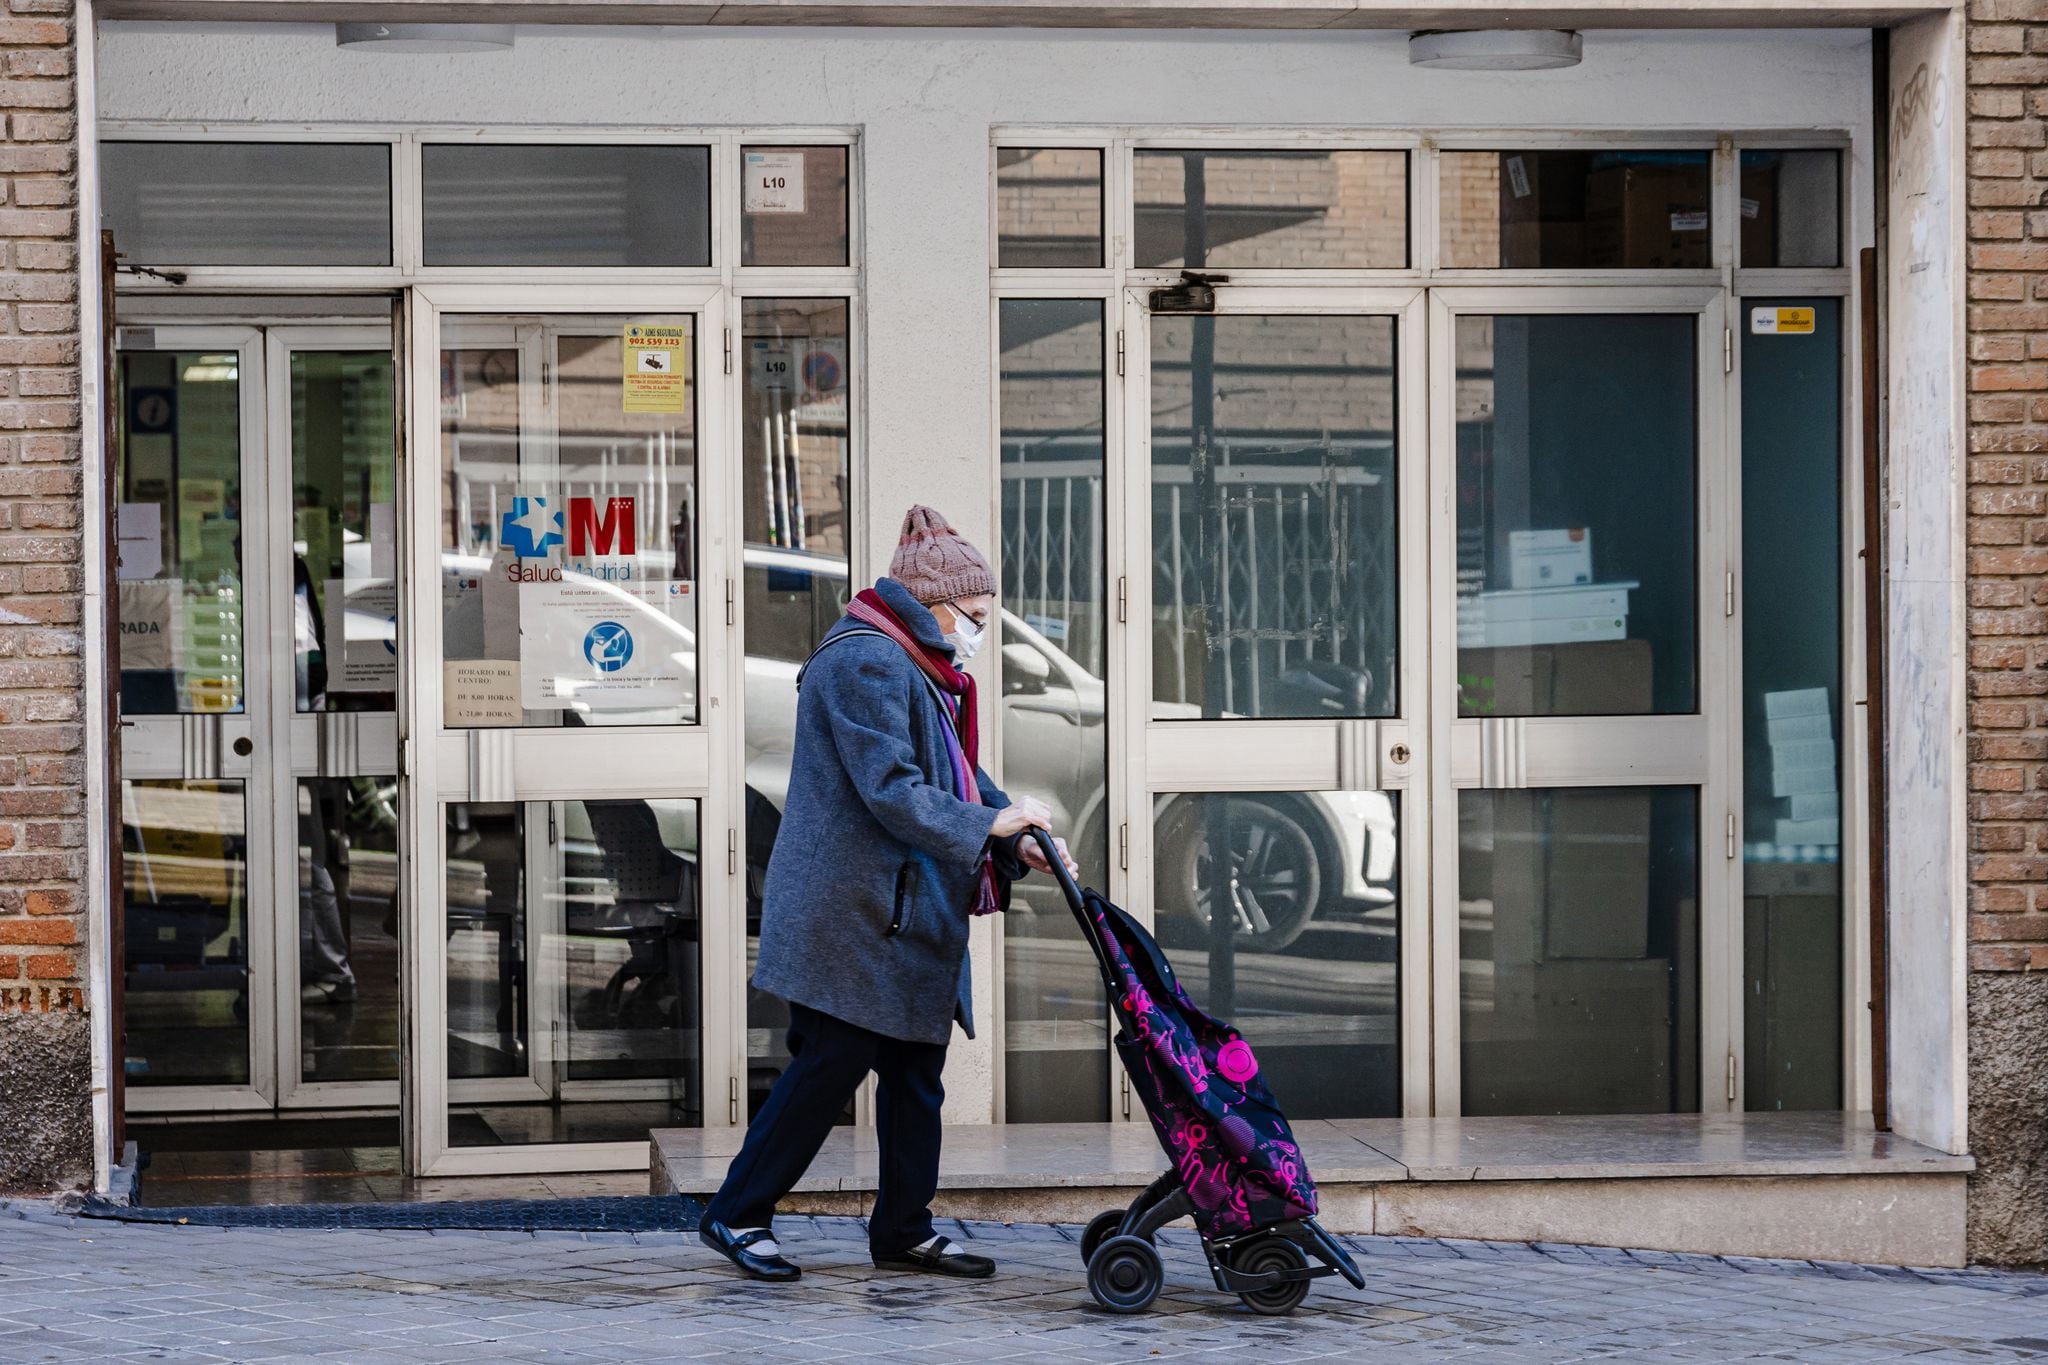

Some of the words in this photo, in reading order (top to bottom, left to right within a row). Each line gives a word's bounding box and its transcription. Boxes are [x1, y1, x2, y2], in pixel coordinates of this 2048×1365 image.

[763, 177, 785, 189] L10
[657, 328, 683, 338] SEGURIDAD
[629, 337, 645, 345] 902
[647, 338, 663, 346] 539
[665, 338, 680, 346] 123
[766, 361, 786, 372] L10
[568, 497, 636, 557] M
[458, 668, 494, 676] HORARIO
